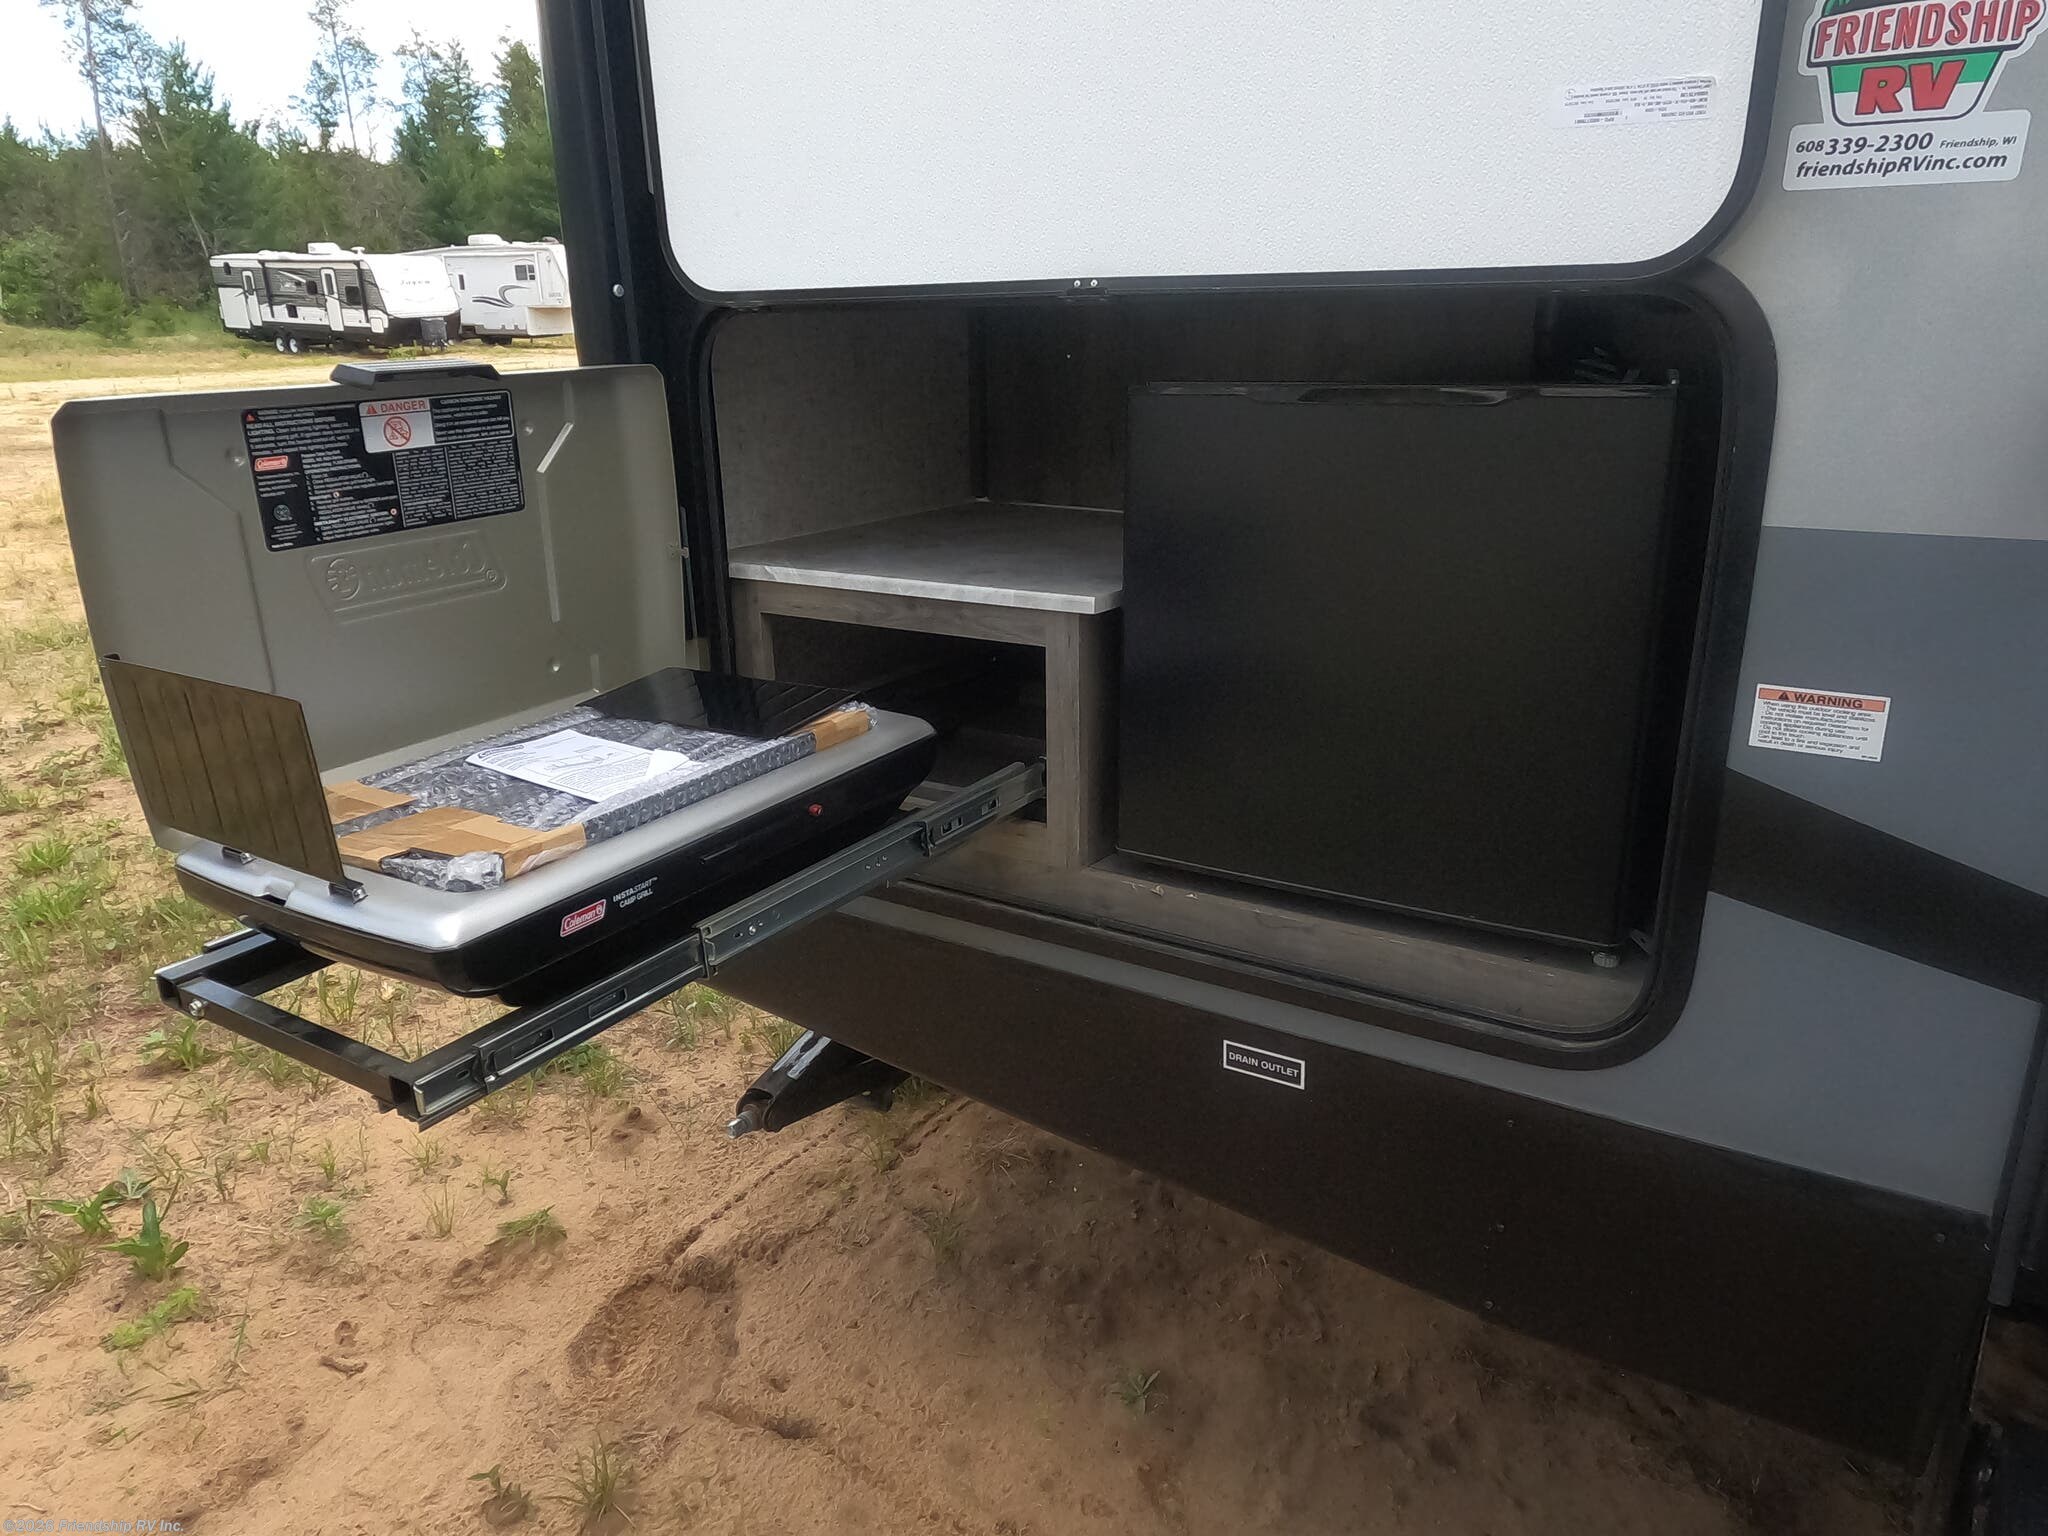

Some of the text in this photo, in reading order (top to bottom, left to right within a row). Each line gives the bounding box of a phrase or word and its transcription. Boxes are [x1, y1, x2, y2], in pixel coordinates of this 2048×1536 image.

[1814, 0, 2041, 58] FRIENDSHIP
[1855, 59, 1967, 115] RV
[1796, 132, 2017, 156] 608 339-2300 Friendship, WI
[1796, 153, 2008, 178] friendshipRVinc.com
[381, 400, 425, 412] DANGER
[1794, 694, 1863, 709] WARNING
[563, 904, 600, 931] Coleman
[1229, 1052, 1299, 1078] DRAIN OUTLET
